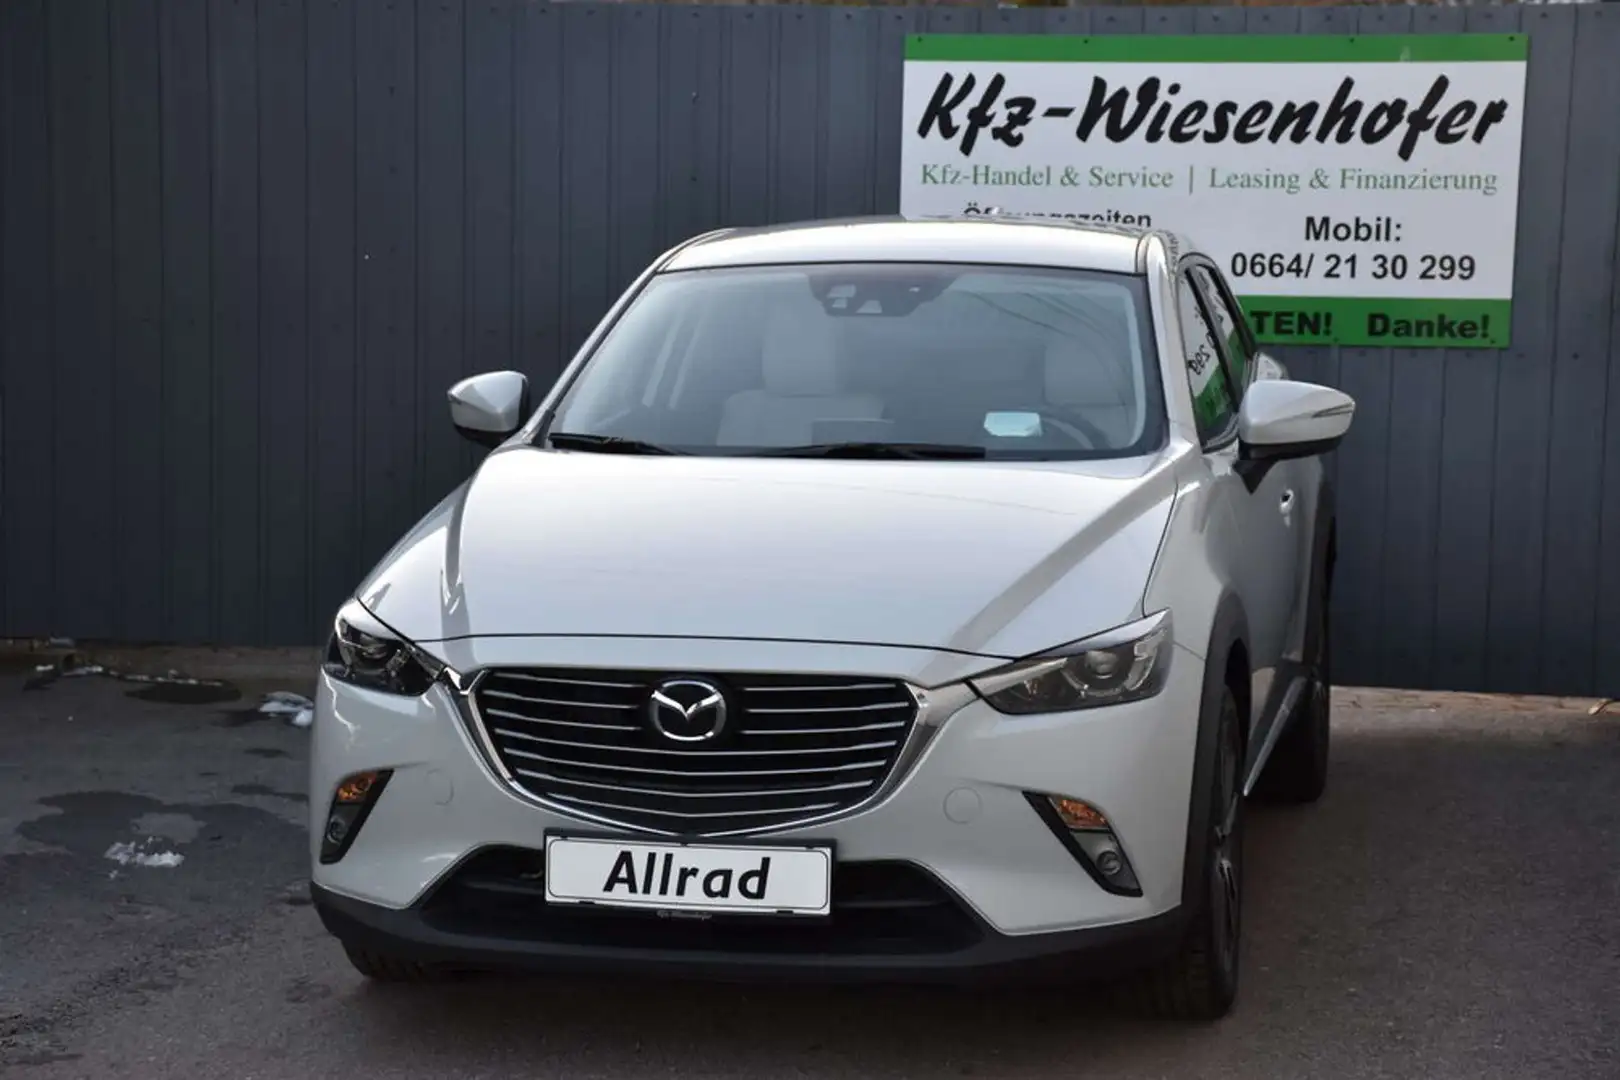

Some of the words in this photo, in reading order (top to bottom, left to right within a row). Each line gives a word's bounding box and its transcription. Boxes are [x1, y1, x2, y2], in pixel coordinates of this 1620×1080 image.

[917, 73, 1507, 161] Kfz-Wiesenhofer
[921, 162, 1053, 188] Kfz-Handel
[1059, 167, 1080, 187] &
[1089, 165, 1174, 188] Service
[1209, 168, 1301, 195] Leasing
[1308, 169, 1329, 189] &
[1339, 168, 1498, 195] Finanzierung
[1304, 217, 1402, 242] Mobil:
[1231, 253, 1315, 279] 0664/
[1324, 254, 1358, 279] 21
[1371, 255, 1408, 280] 30
[1419, 256, 1476, 281] 299
[1367, 313, 1491, 339] Danke!
[602, 850, 771, 900] Allrad
